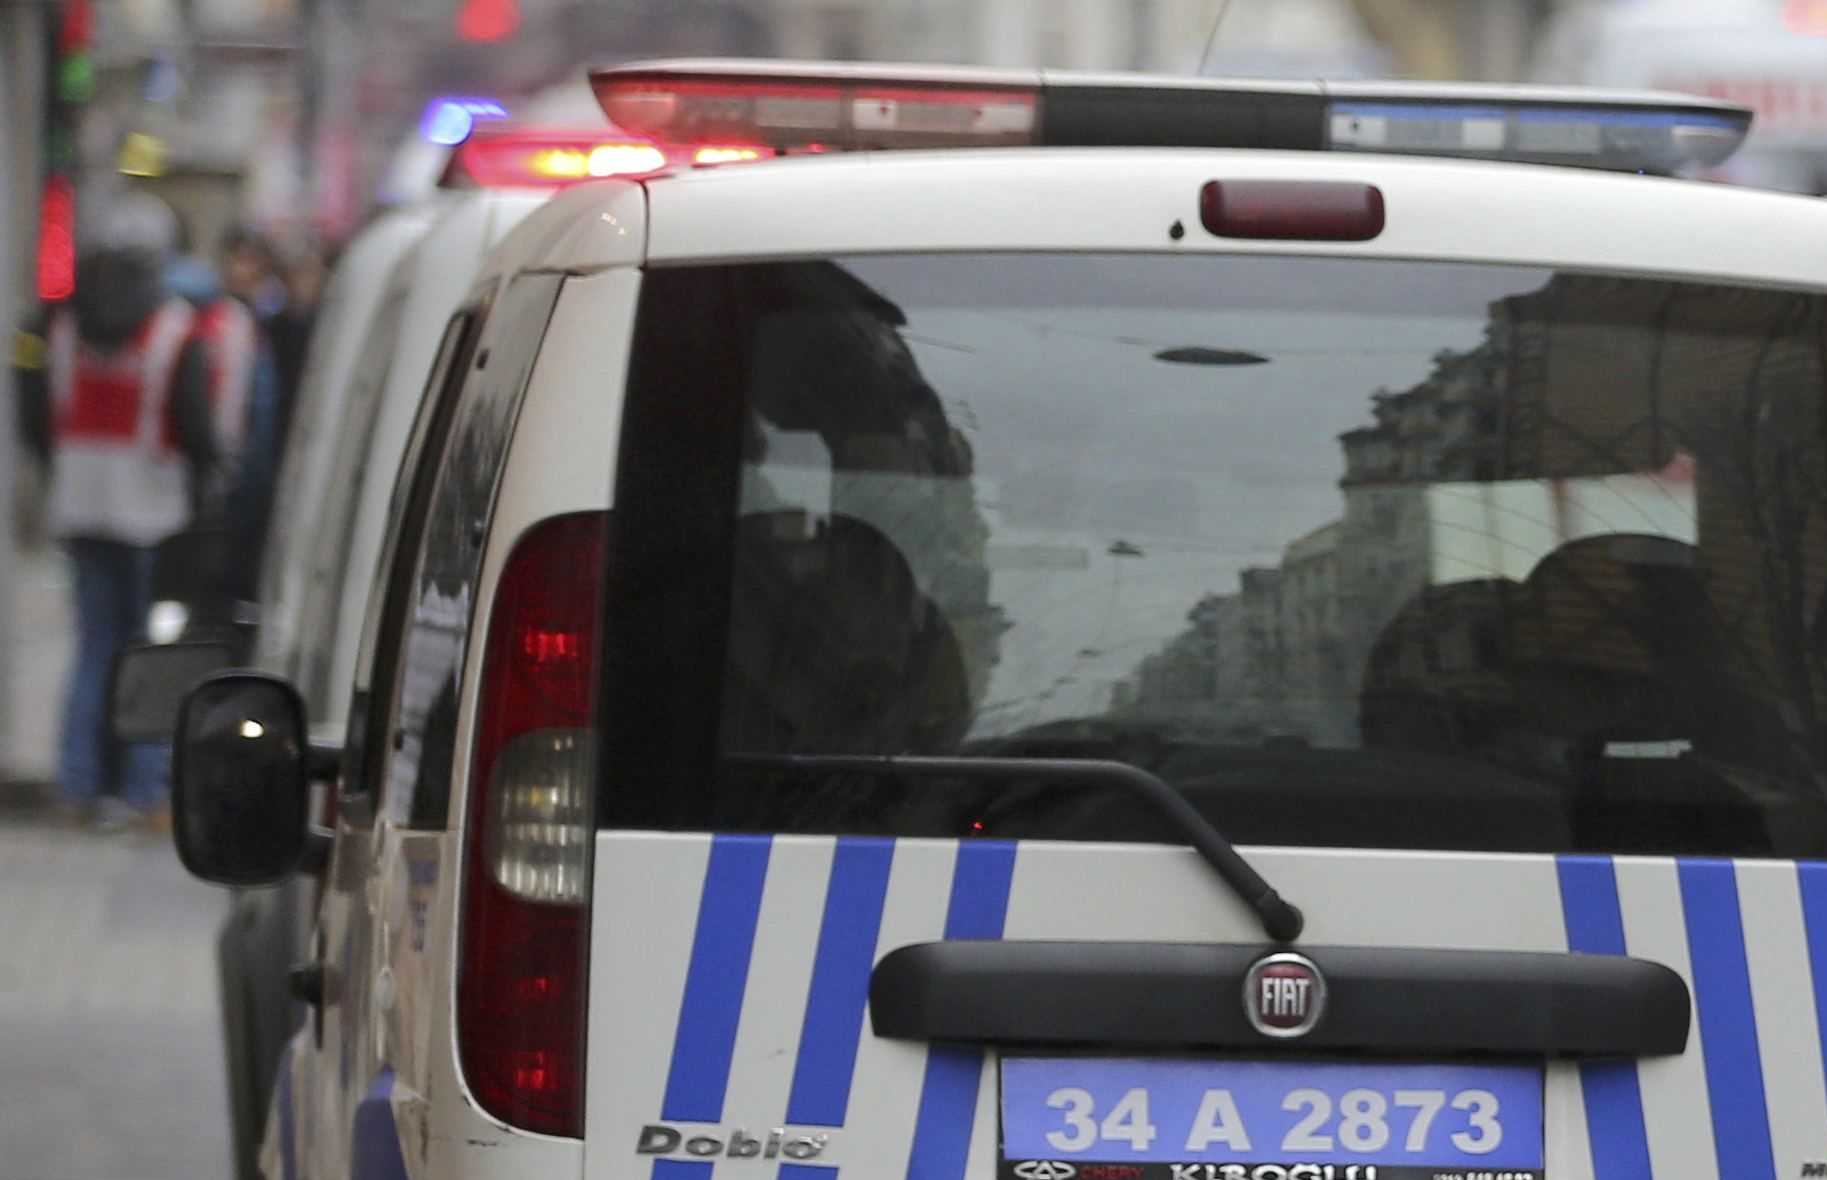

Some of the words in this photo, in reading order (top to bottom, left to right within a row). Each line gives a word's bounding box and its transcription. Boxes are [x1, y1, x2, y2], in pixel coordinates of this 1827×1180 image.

[1261, 977, 1309, 1016] FIAT
[1045, 1088, 1155, 1152] 34
[1185, 1089, 1251, 1152] A
[1280, 1089, 1501, 1154] 2873
